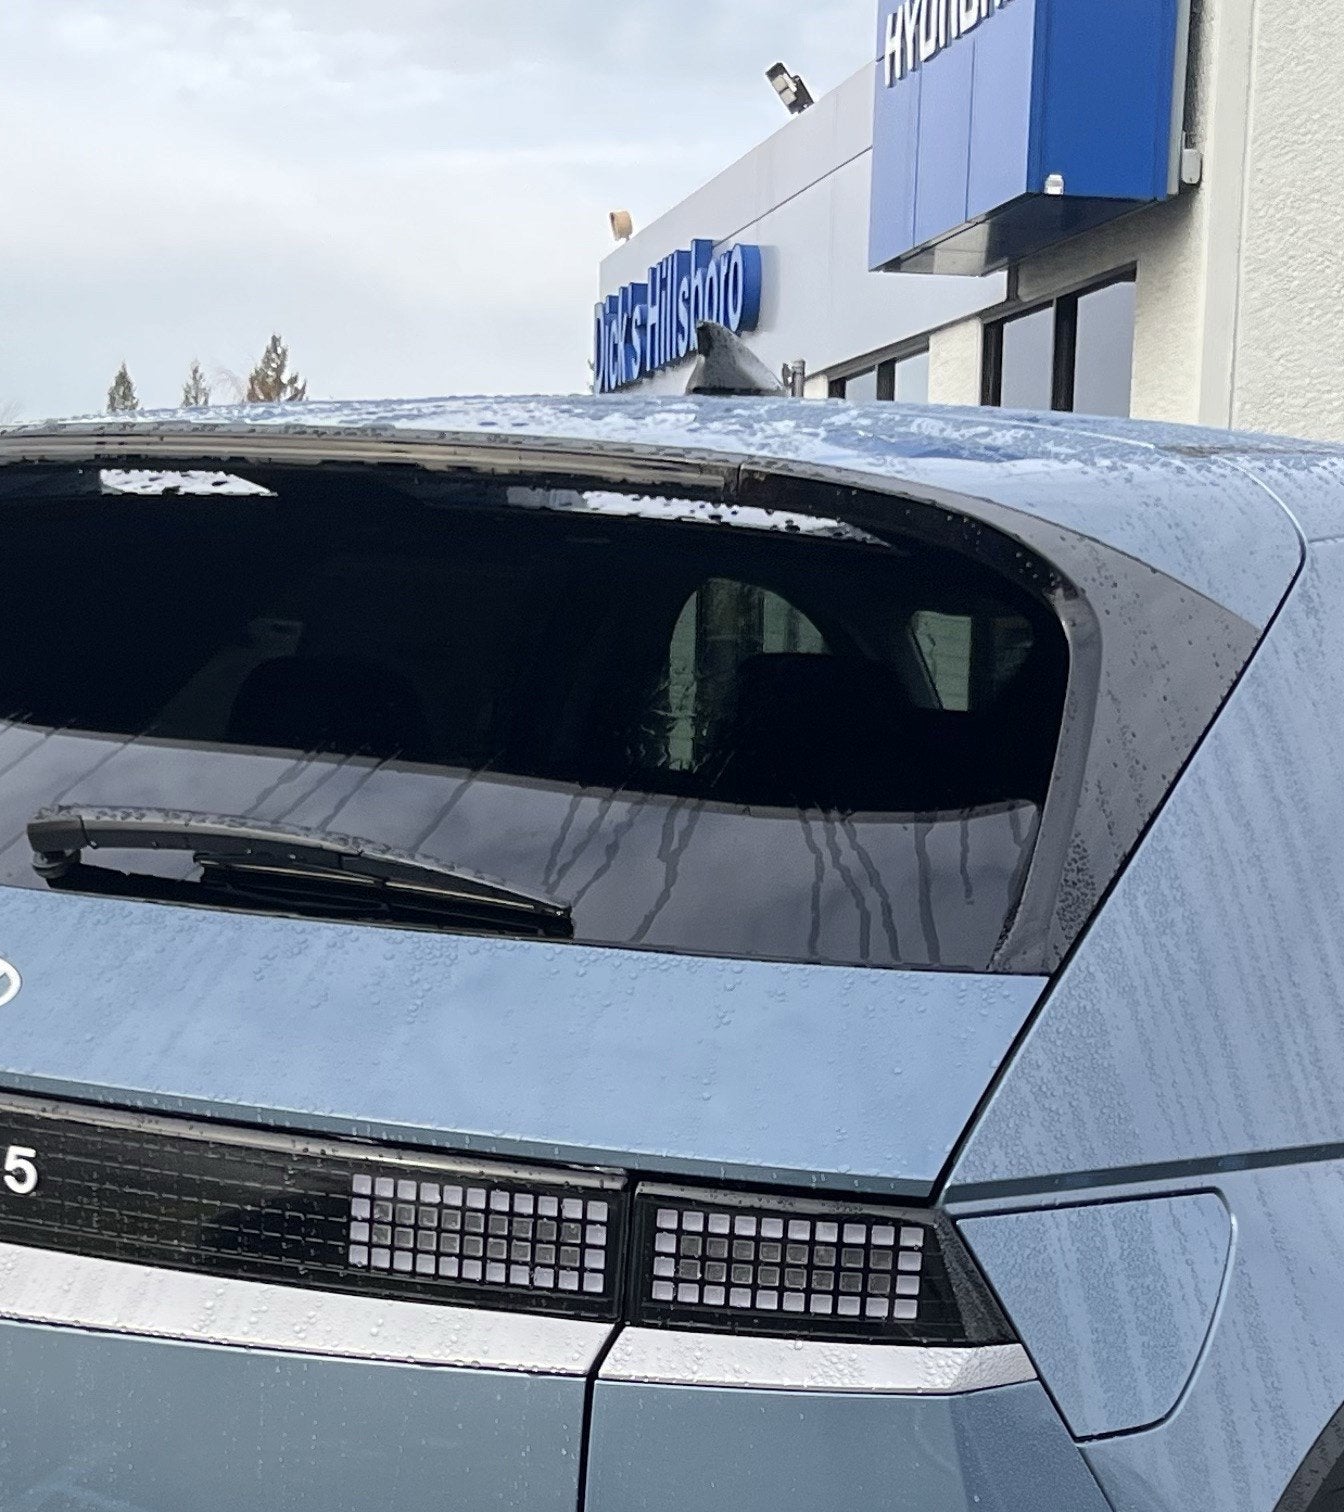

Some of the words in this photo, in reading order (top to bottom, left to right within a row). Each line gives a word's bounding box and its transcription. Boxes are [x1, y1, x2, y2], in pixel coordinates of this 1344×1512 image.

[594, 281, 642, 397] Dick's
[645, 239, 746, 371] Hillsboro
[3, 1145, 38, 1194] 5
